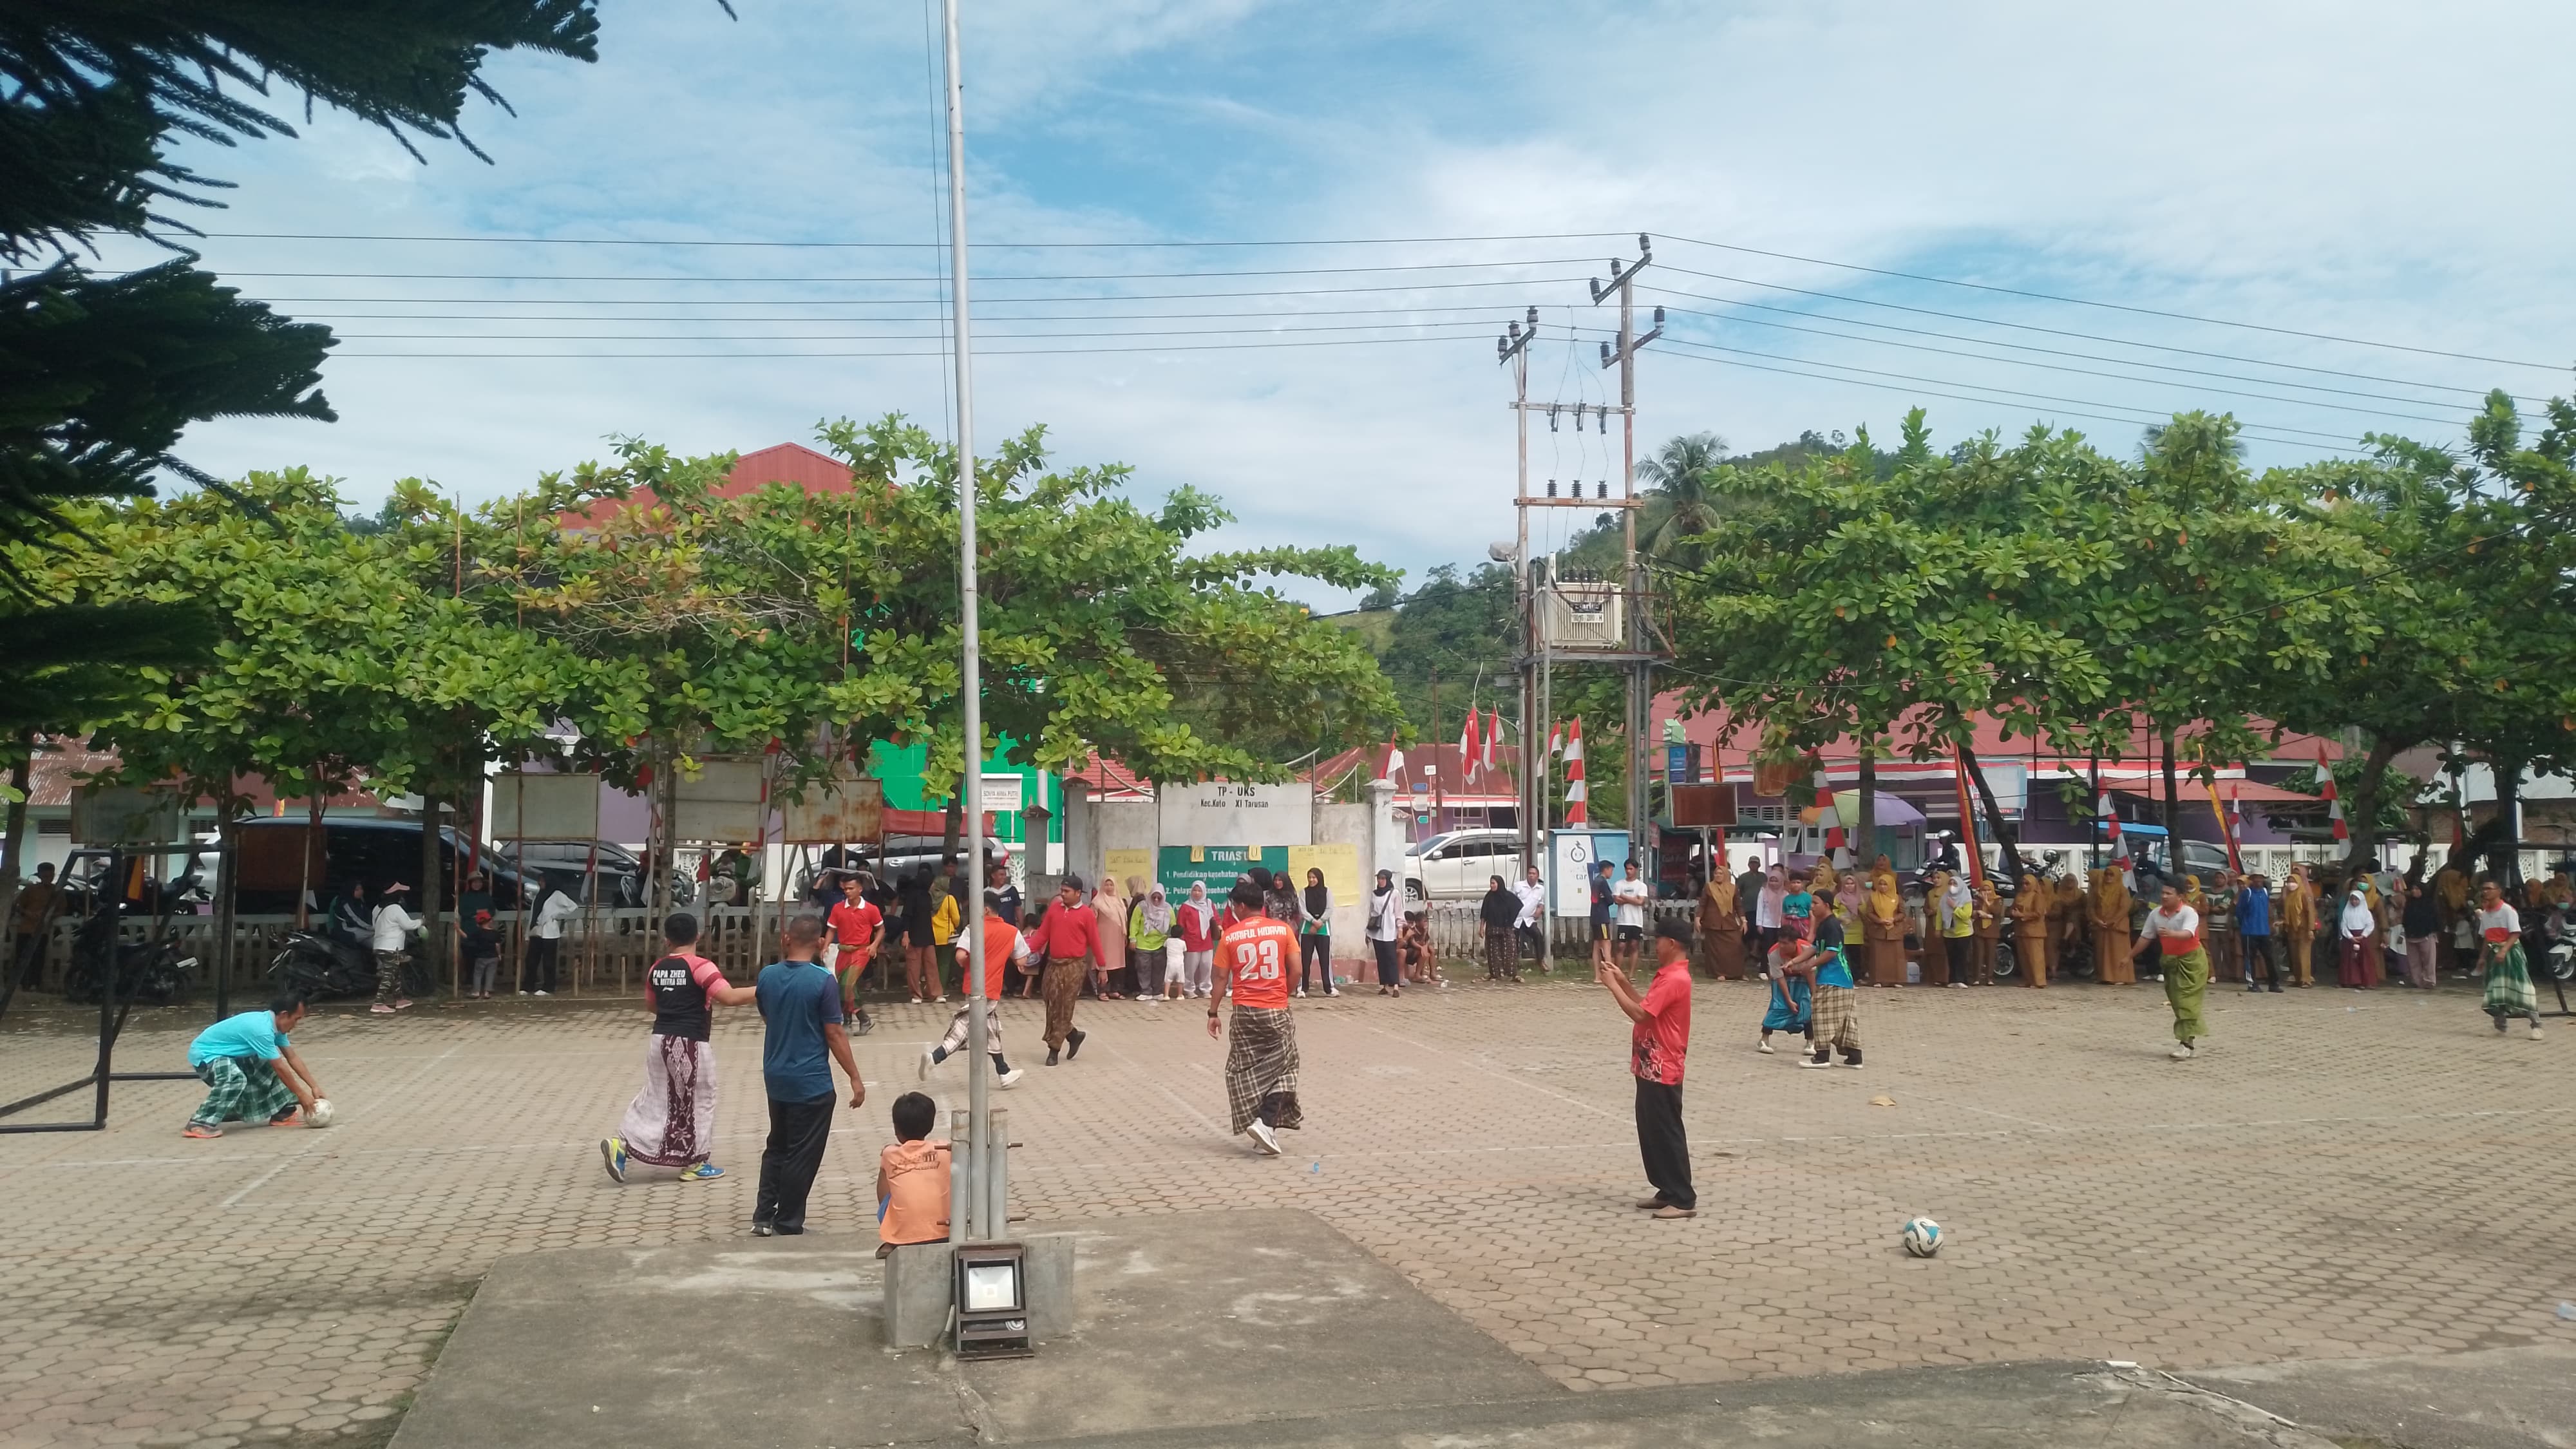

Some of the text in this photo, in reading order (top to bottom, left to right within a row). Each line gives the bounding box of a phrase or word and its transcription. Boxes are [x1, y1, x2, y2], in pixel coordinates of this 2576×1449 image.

[1217, 786, 1227, 797] TP
[1237, 786, 1255, 797] UKS
[1235, 799, 1242, 808] XI
[1245, 799, 1269, 808] Tarusan
[1211, 851, 1242, 861] TRIAS
[1208, 870, 1238, 878] kesehatan
[1236, 940, 1279, 981] 23
